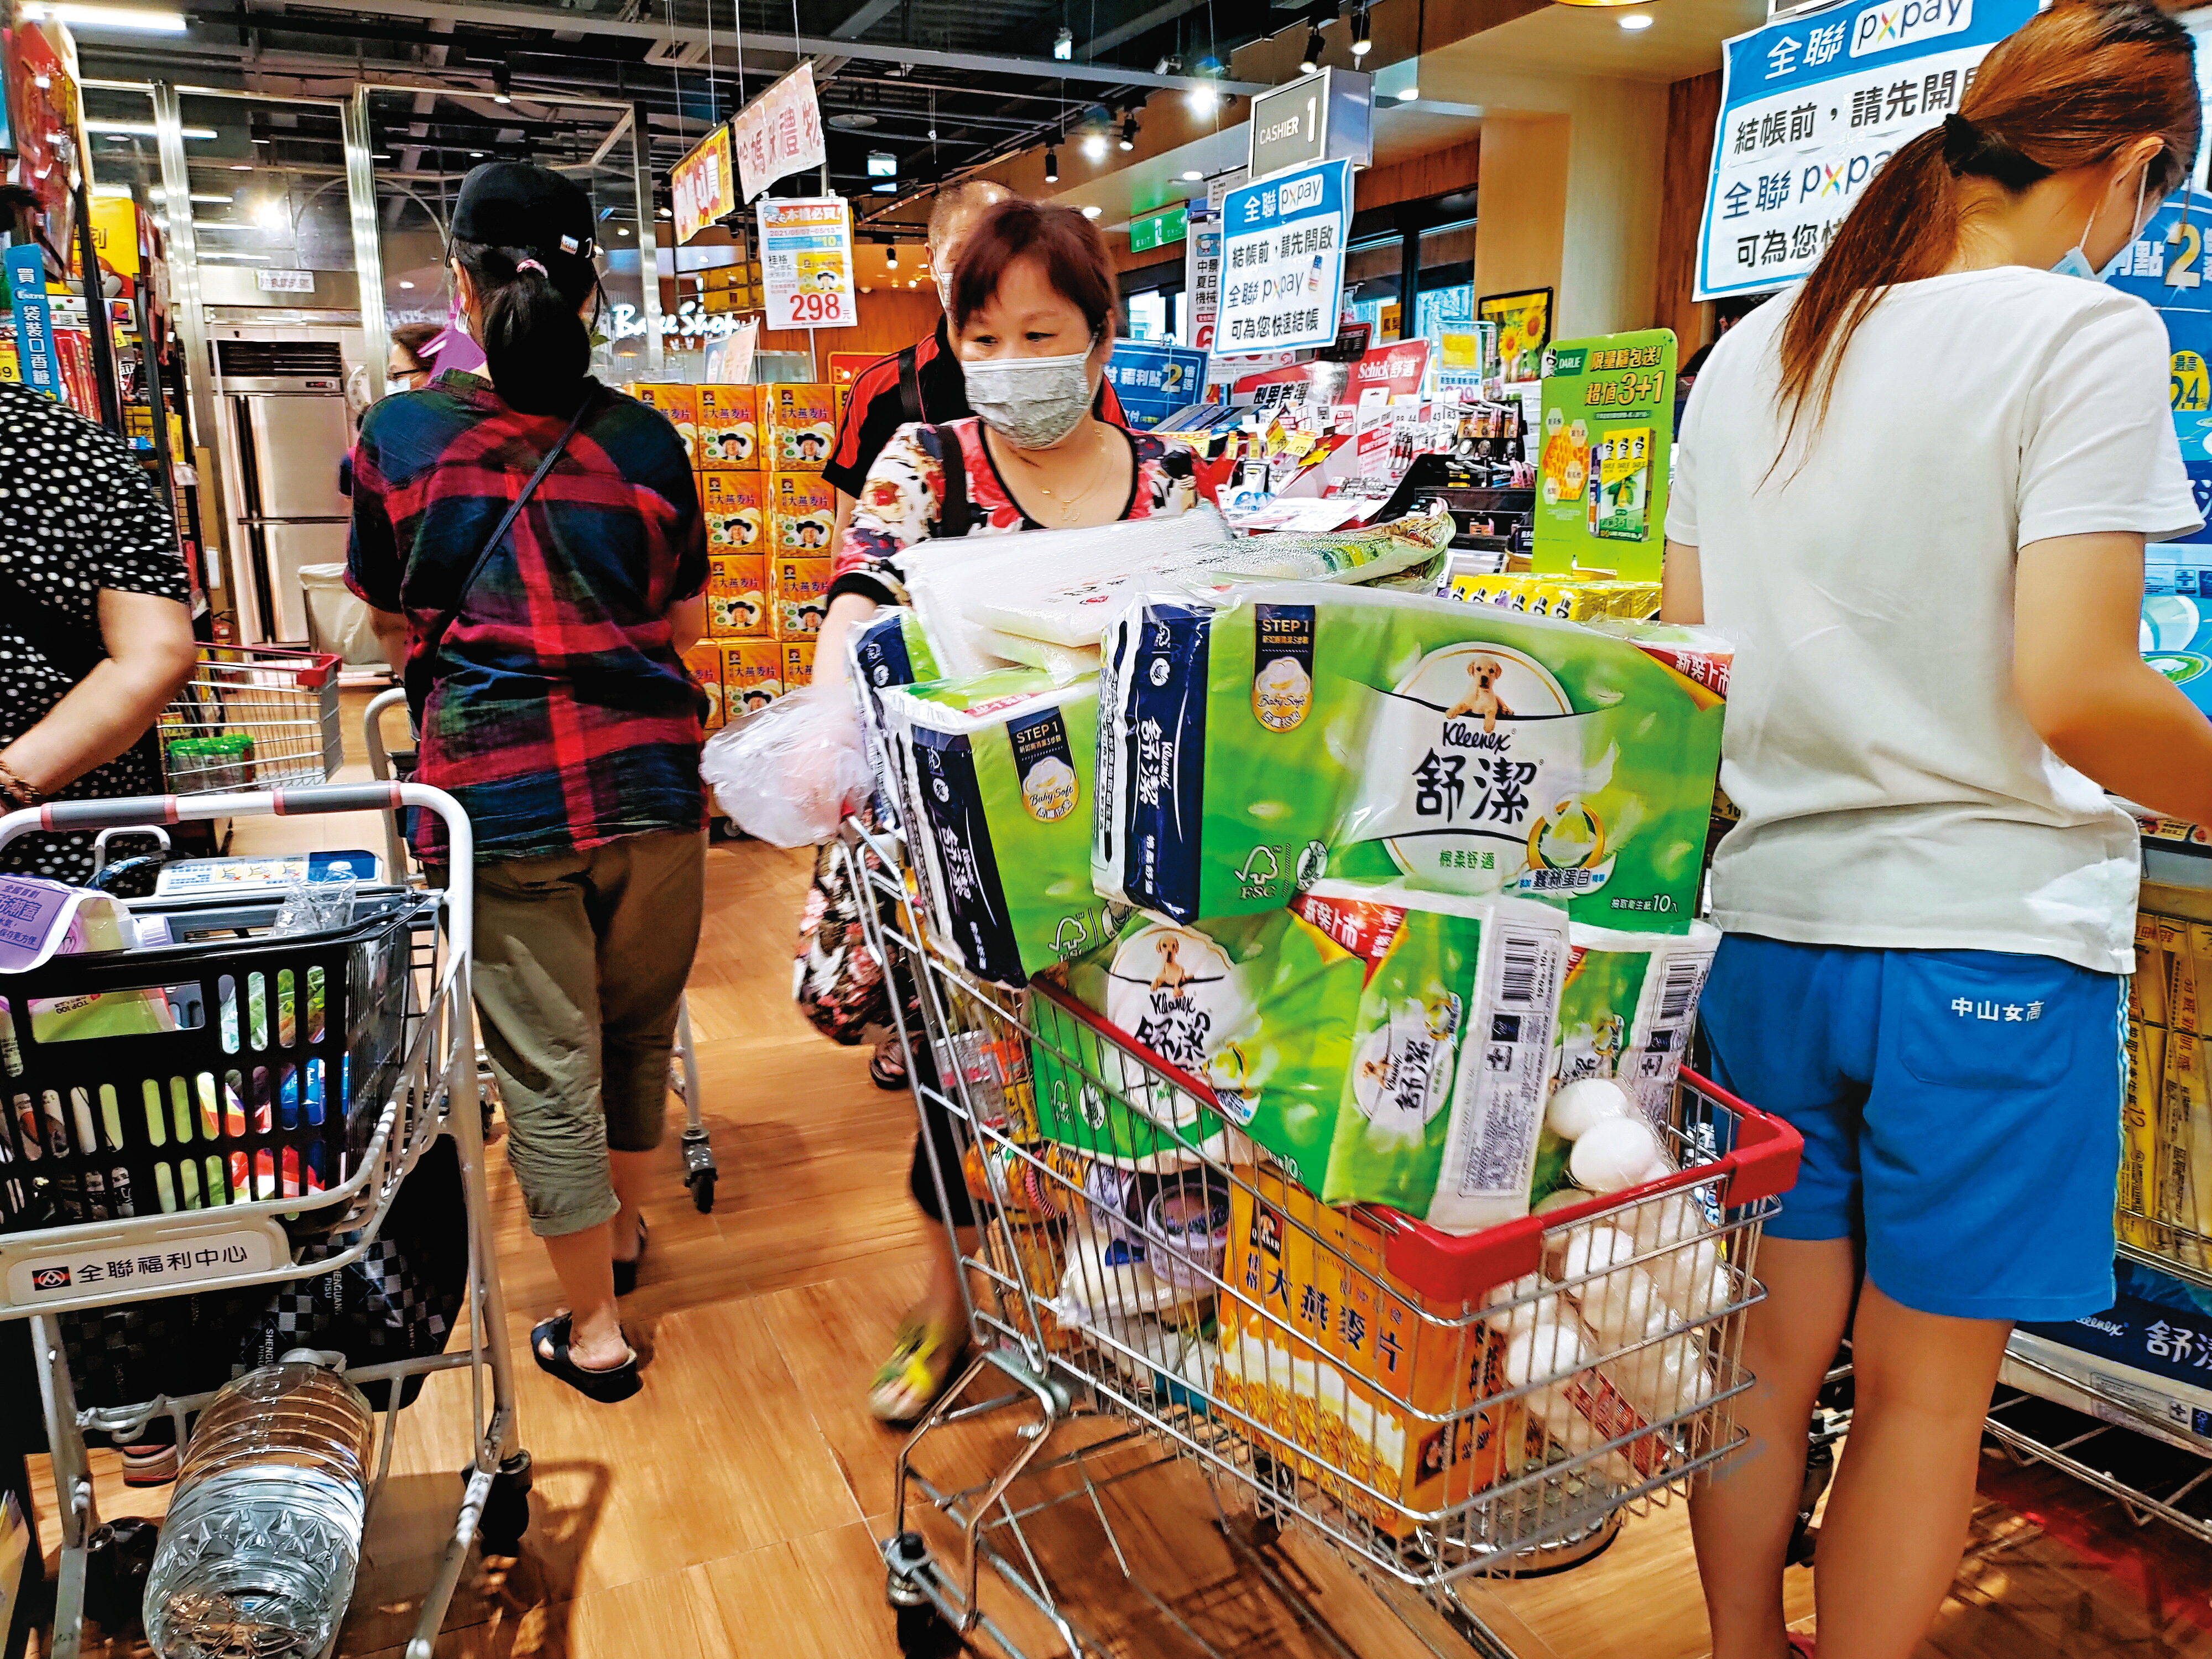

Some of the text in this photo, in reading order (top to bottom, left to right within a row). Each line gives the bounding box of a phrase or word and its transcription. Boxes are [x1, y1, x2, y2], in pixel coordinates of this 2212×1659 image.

[1765, 19, 1847, 79] 全聯
[1259, 96, 1317, 145] CASHIER 1
[1244, 189, 1276, 223] 全聯
[1281, 179, 1321, 210] pxpay
[1723, 170, 1791, 220] 全聯
[1136, 236, 1150, 248] EXIT
[1232, 225, 1333, 269] 結帳前，請先開啟
[17, 268, 35, 284] 買
[1228, 270, 1304, 309] 全聯 pxpay
[790, 293, 852, 321] 298 元
[1231, 307, 1320, 341] 可為您快速結帳
[23, 305, 50, 385] 袋裝口香糖
[1358, 360, 1389, 379] Schick
[1558, 357, 1582, 369] DARLIE
[709, 408, 750, 419] 大燕麥片
[787, 408, 829, 419] 大燕麥片
[1295, 446, 1307, 455] 179
[715, 494, 756, 505] 大燕麥片
[788, 494, 829, 507] 大燕麥片
[719, 578, 759, 588] 大燕麥片
[1262, 619, 1309, 633] STEP 1
[735, 666, 776, 677] 大燕麥片
[1016, 721, 1058, 744] STEP 1
[1443, 721, 1512, 752] Kleenex
[1140, 716, 1162, 810] 舒潔
[1029, 784, 1073, 807] Baby Soft
[1412, 747, 1537, 825] 舒潔
[56, 1000, 89, 1014] TOP 100
[1951, 997, 2045, 1022] 中山女高
[1252, 1229, 1280, 1253] QAKER
[77, 1245, 247, 1284] 全聯福利中心
[1265, 1266, 1404, 1373] 大燕麥片
